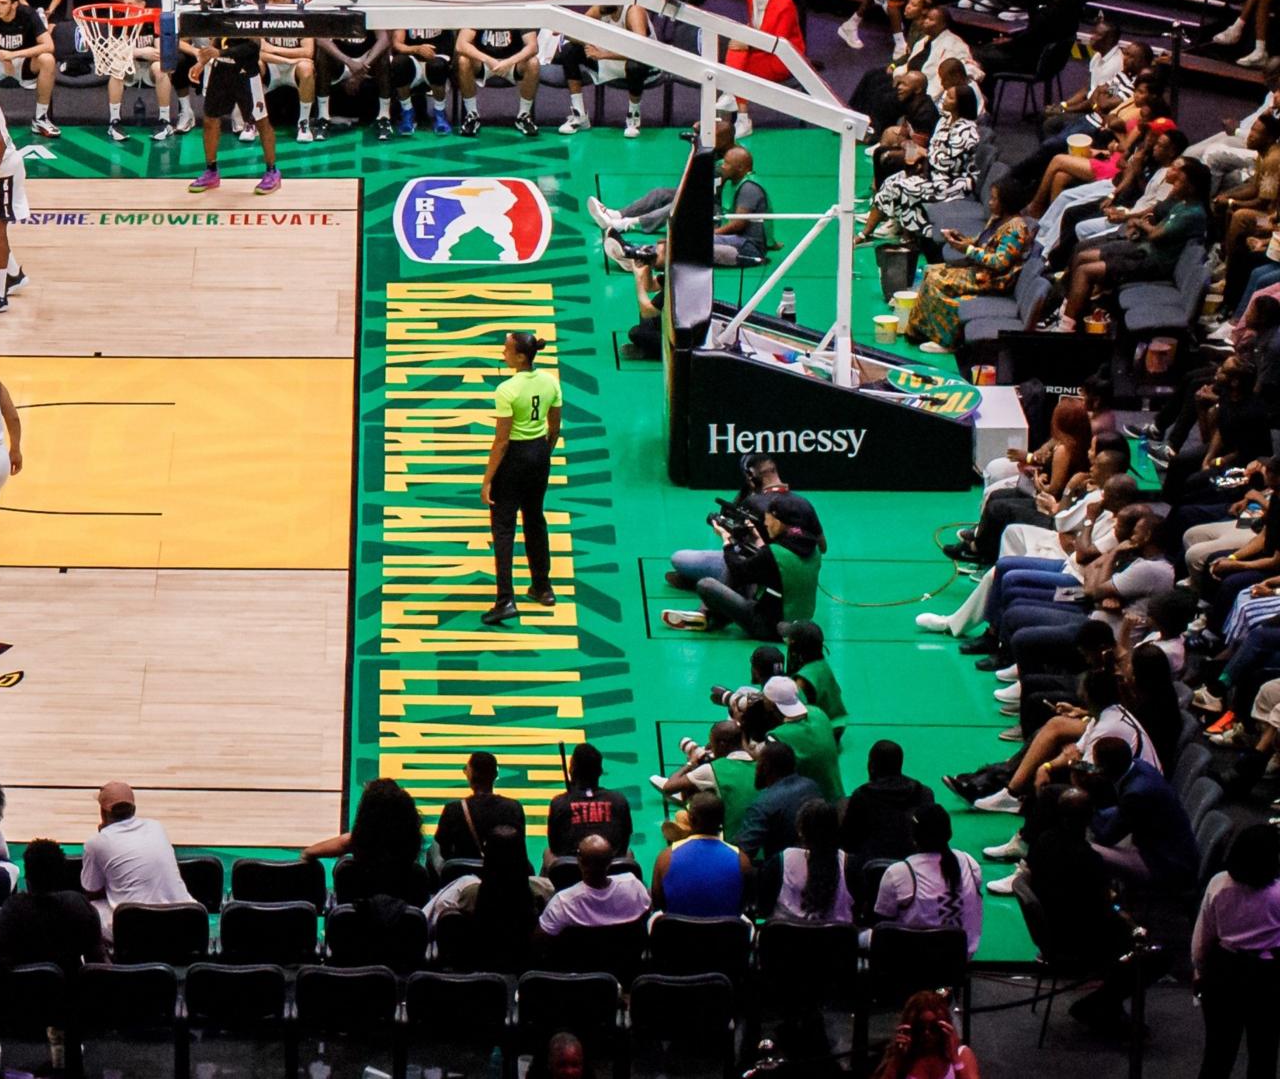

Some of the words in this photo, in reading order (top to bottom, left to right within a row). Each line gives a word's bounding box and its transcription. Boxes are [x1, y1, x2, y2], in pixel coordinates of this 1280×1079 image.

[235, 20, 260, 29] VISIT
[262, 19, 304, 29] RWANDA
[10, 212, 95, 226] SPIRE.
[99, 213, 225, 226] EMPOWER.
[229, 213, 341, 226] ELEVATE.
[414, 197, 436, 239] BAL
[531, 394, 540, 422] 8
[707, 422, 868, 458] Hennessy
[381, 506, 578, 653] AFRICA
[377, 669, 587, 836] LEAGU
[569, 801, 611, 824] STAFF
